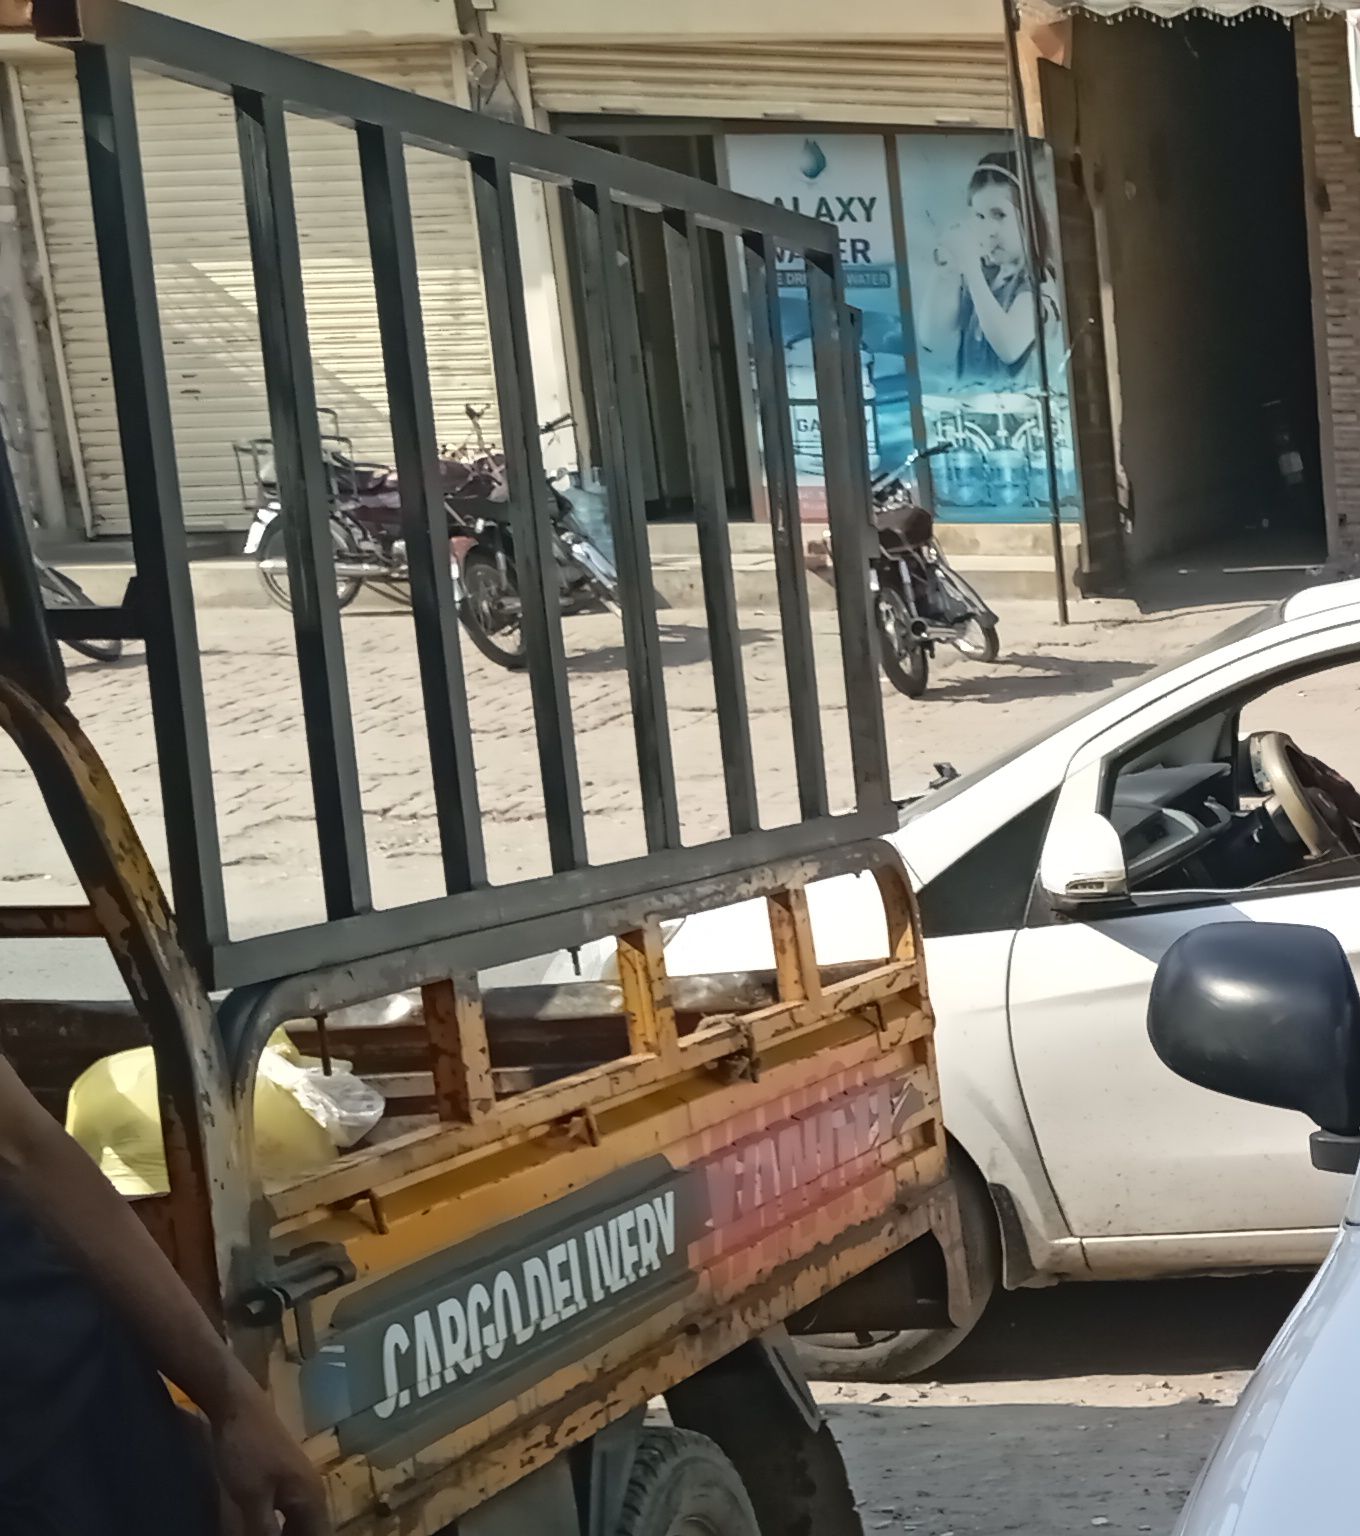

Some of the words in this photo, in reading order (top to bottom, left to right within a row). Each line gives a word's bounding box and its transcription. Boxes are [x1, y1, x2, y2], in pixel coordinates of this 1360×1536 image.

[757, 196, 877, 223] LAXY
[372, 1270, 525, 1419] CARGO
[516, 1191, 675, 1345] DELIVERY
